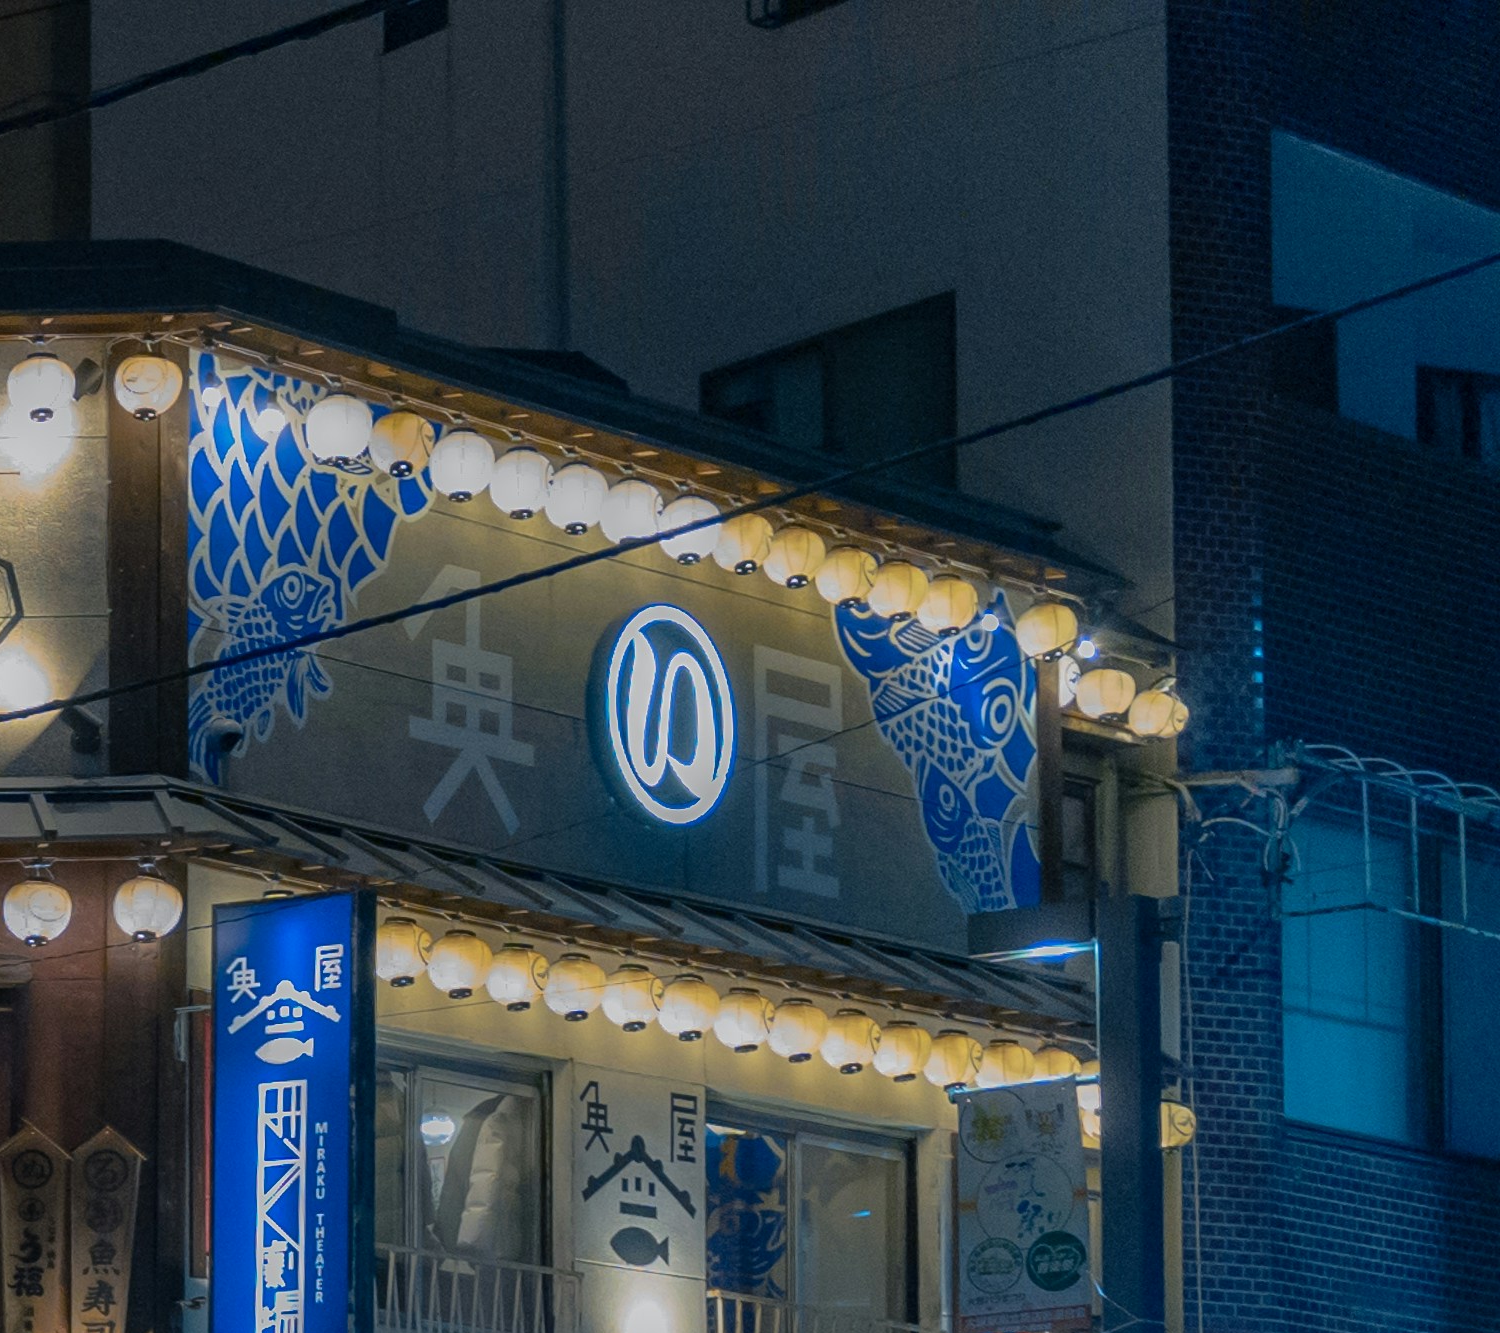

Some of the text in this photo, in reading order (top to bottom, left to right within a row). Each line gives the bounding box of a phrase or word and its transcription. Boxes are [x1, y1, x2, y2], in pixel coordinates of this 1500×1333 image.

[753, 645, 842, 900] 屋
[315, 944, 344, 991] 屋
[670, 1093, 700, 1165] 屋
[314, 1122, 328, 1303] MIRAKU THEATER
